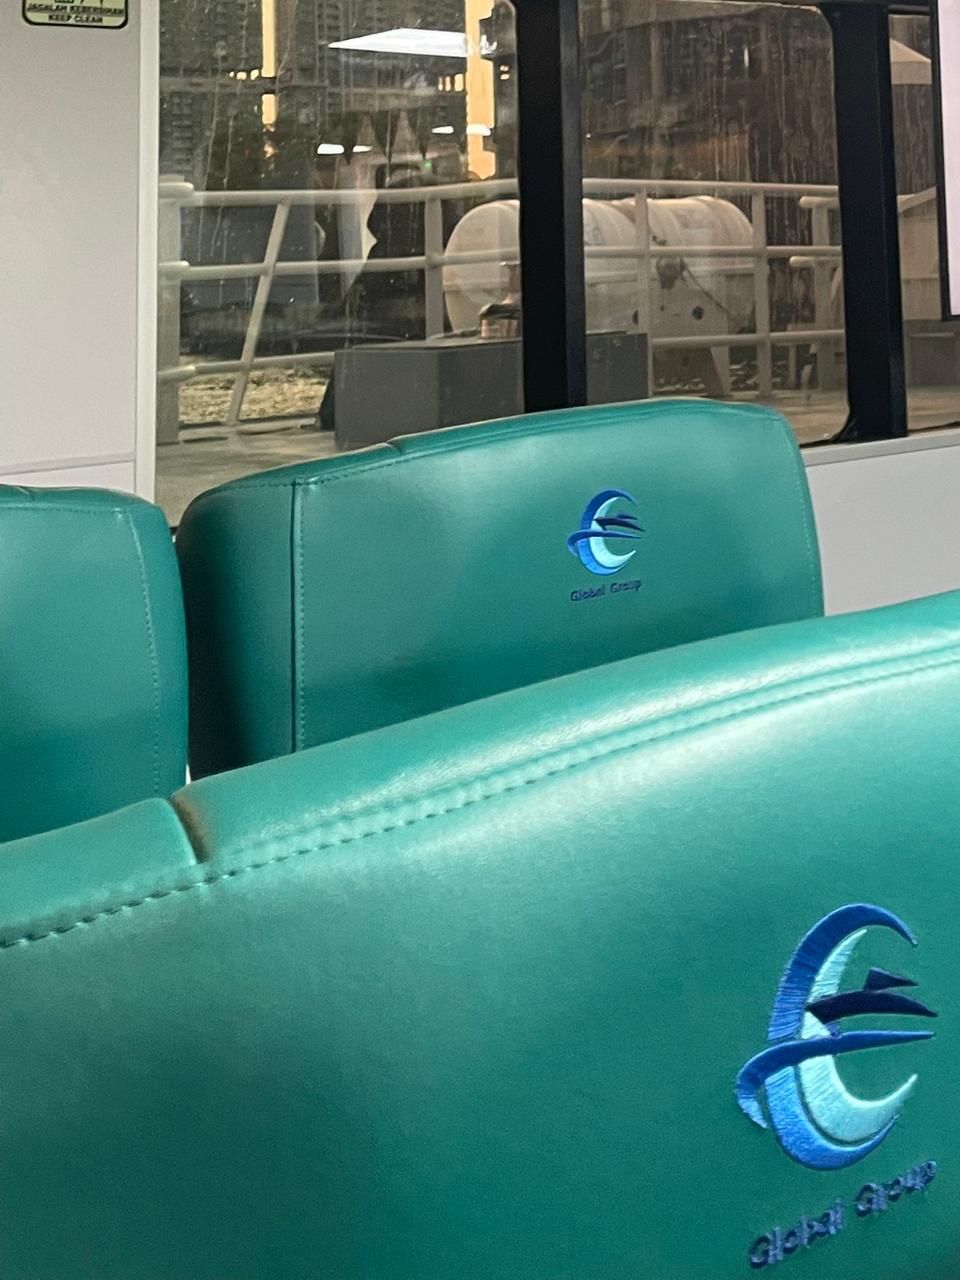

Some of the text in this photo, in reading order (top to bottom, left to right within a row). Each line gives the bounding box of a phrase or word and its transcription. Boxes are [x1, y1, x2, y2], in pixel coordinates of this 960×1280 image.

[48, 14, 103, 24] KEEP CLEAN
[570, 584, 605, 601] Global
[748, 1159, 937, 1269] Global Group
